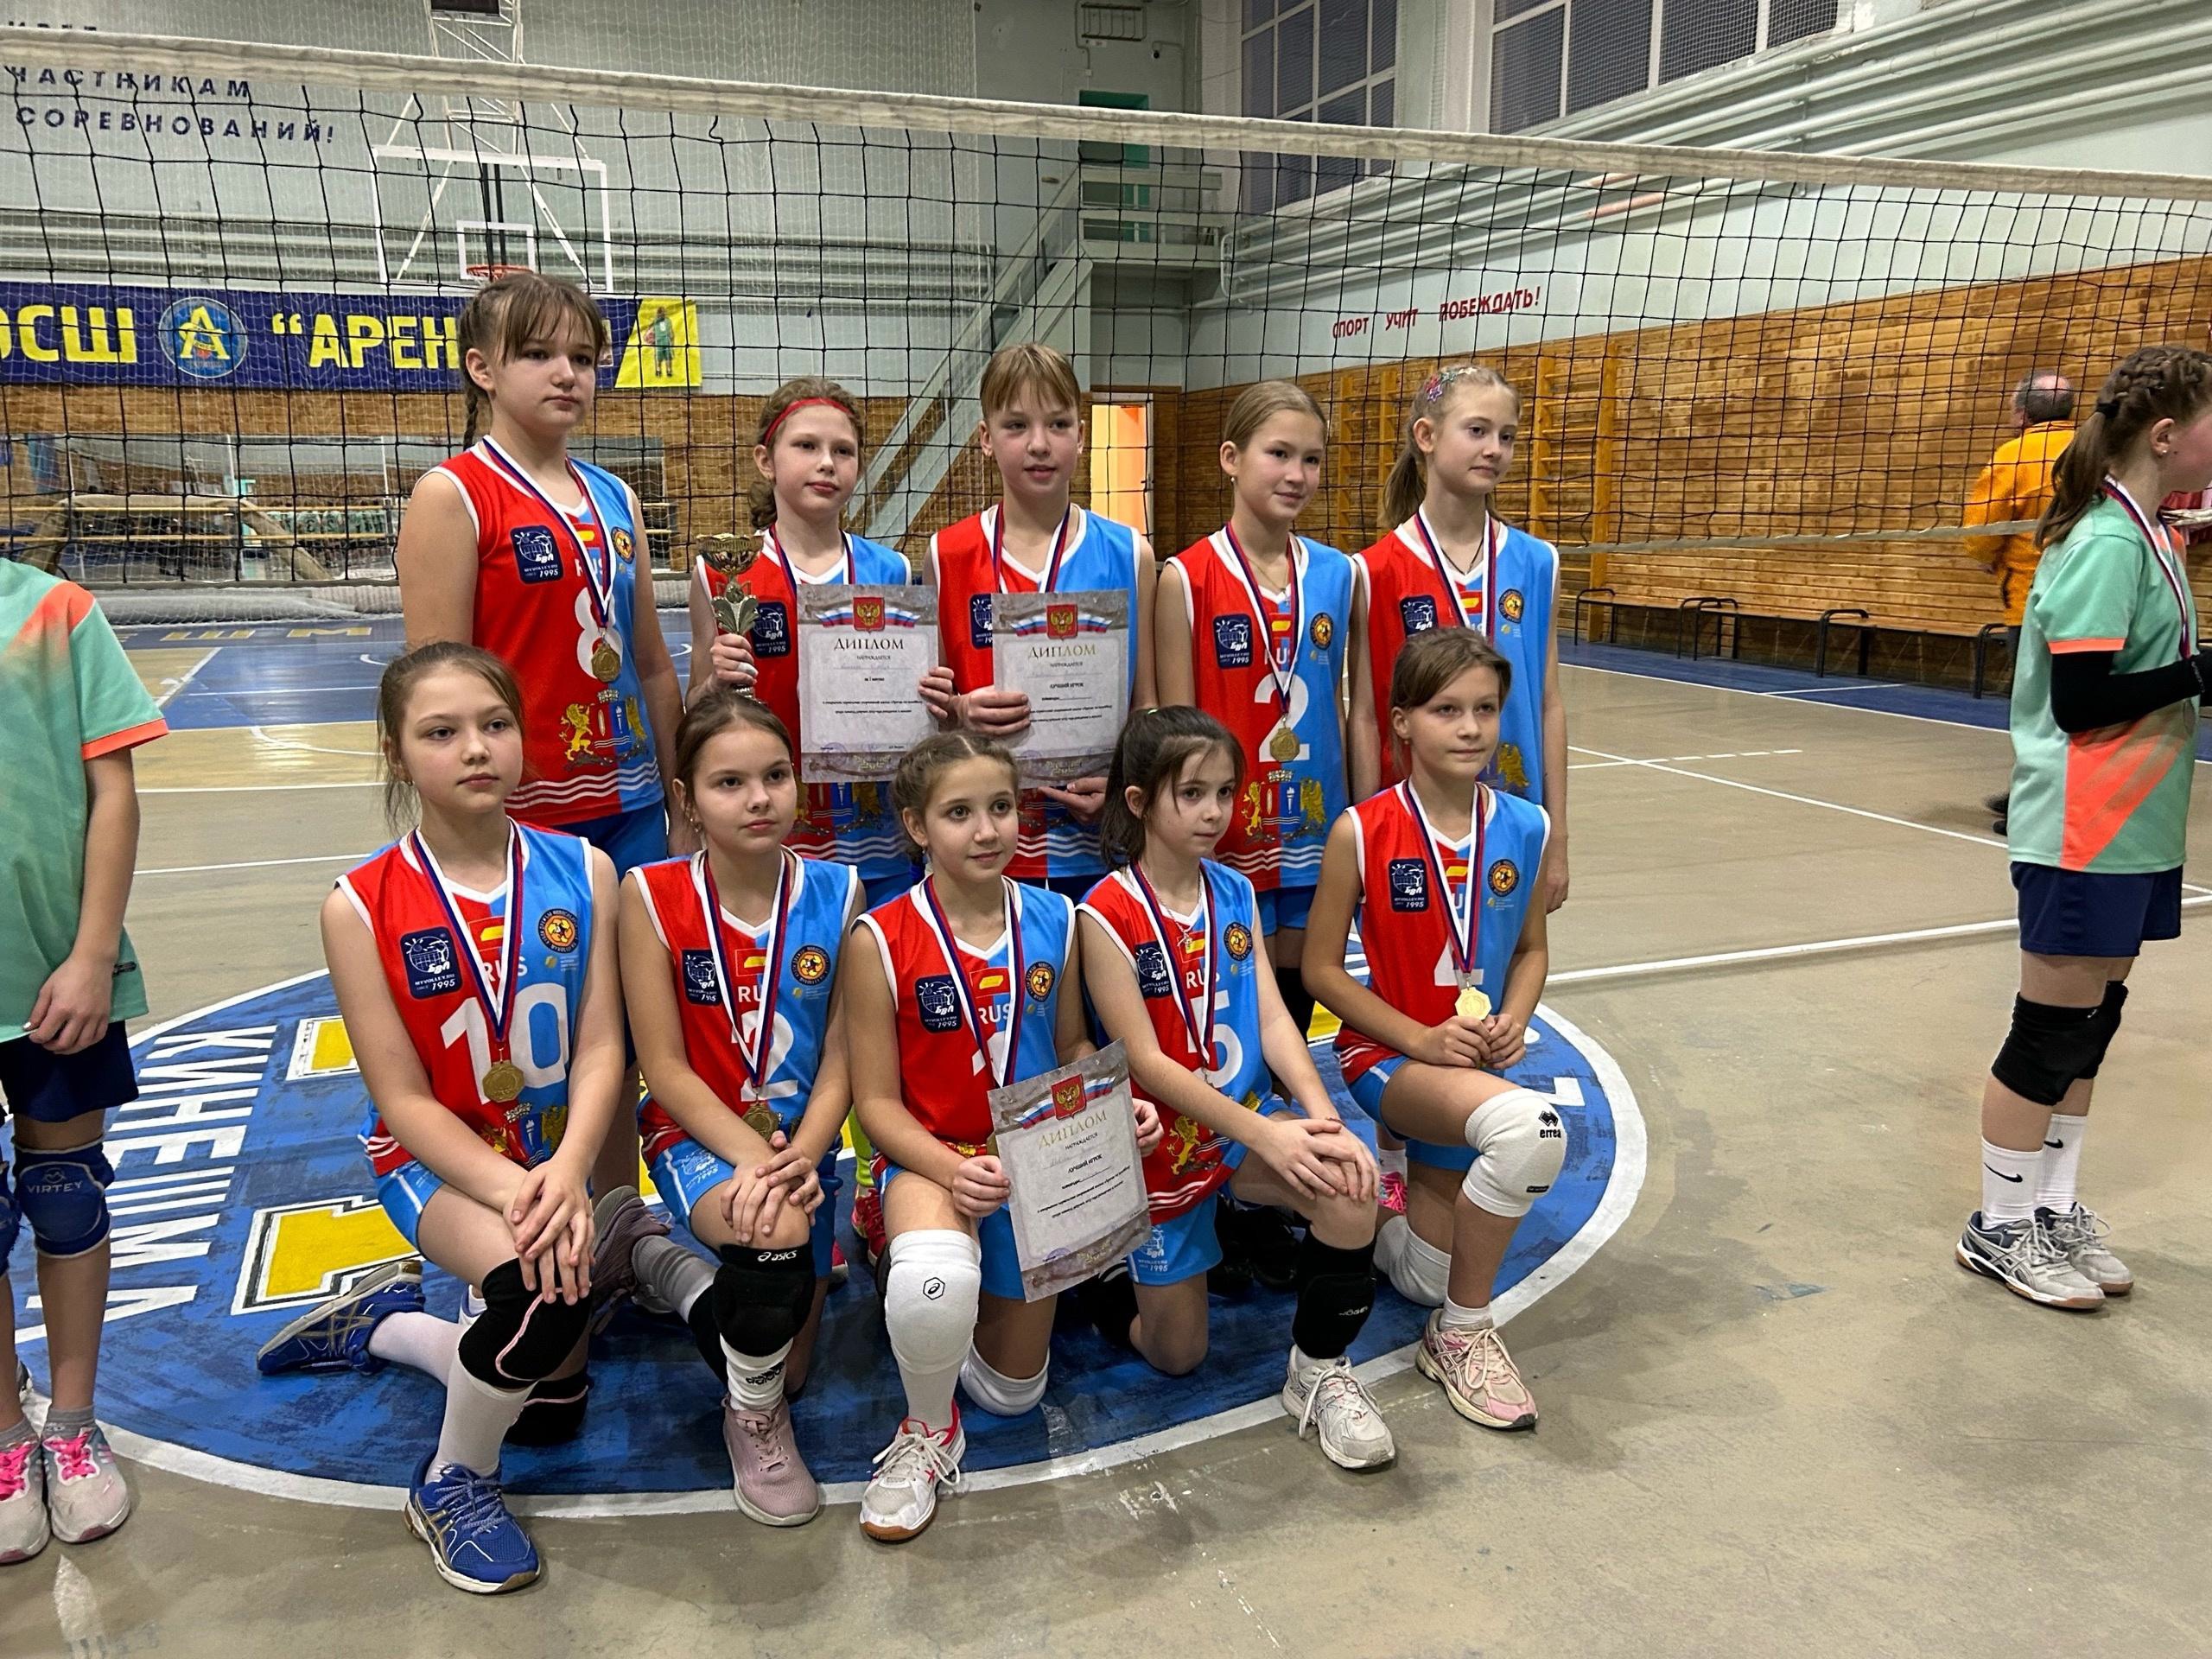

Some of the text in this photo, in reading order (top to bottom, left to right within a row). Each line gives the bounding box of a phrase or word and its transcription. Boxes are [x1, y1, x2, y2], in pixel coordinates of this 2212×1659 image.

[16, 106, 334, 143] СОРЕВНОВАНИЙ!
[1332, 286, 1541, 339] СПОРТ УЧИТ ПОБЕЖДАТЬ!
[0, 304, 137, 363] СШ
[539, 569, 559, 578] 1995
[834, 638, 905, 652] ДИПЛОМ
[1027, 643, 1096, 659] ДИПЛОМ
[1255, 671, 1310, 762] 2
[432, 978, 456, 991] 1995
[1154, 984, 1170, 994] 1995
[938, 1020, 957, 1028] 1995
[441, 982, 569, 1105] 10
[1039, 1109, 1108, 1150] ДИПЛОМ
[27, 1179, 83, 1193] VIRTEY
